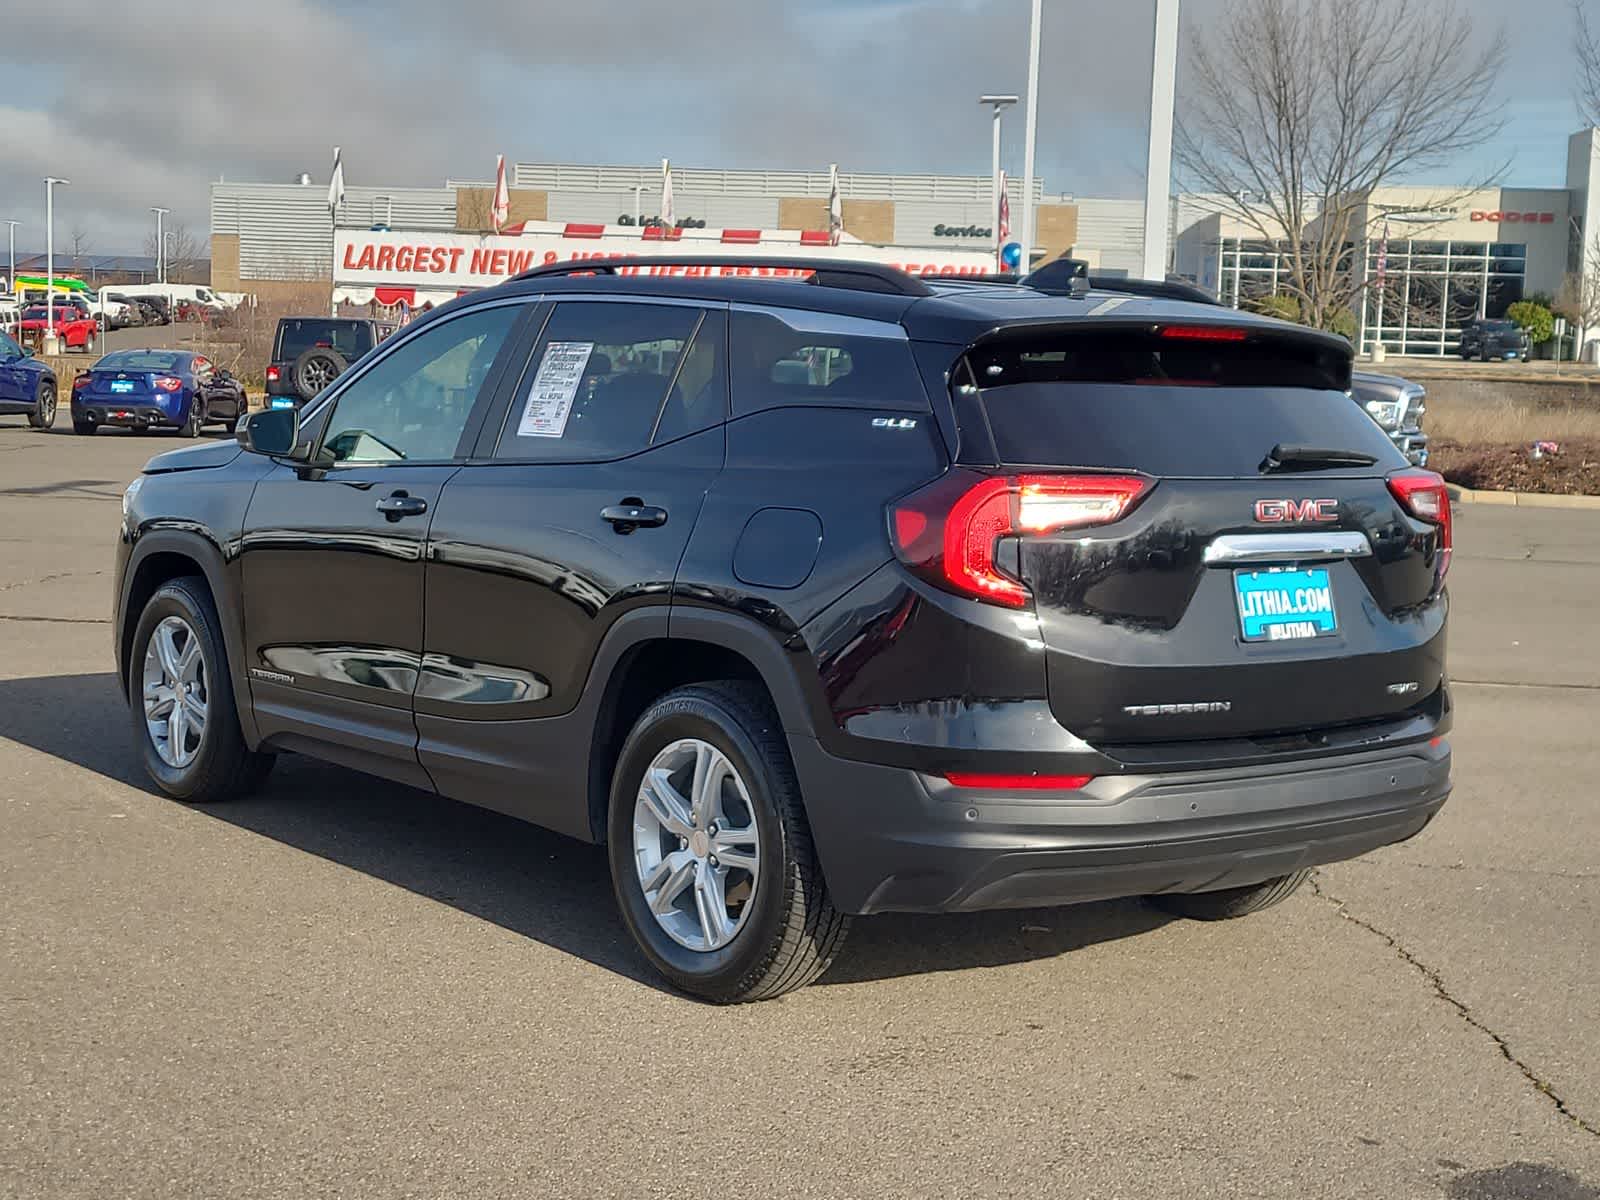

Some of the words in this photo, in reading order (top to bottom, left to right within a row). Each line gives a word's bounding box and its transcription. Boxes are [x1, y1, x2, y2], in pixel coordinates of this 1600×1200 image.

[675, 216, 706, 228] ube
[1470, 211, 1555, 223] DODGE
[933, 224, 993, 237] Service
[343, 244, 465, 273] LARGEST
[470, 249, 535, 275] NEW
[1255, 499, 1339, 522] GMC
[1239, 587, 1332, 617] LITHIA.COM
[1124, 702, 1231, 716] TERRAIN
